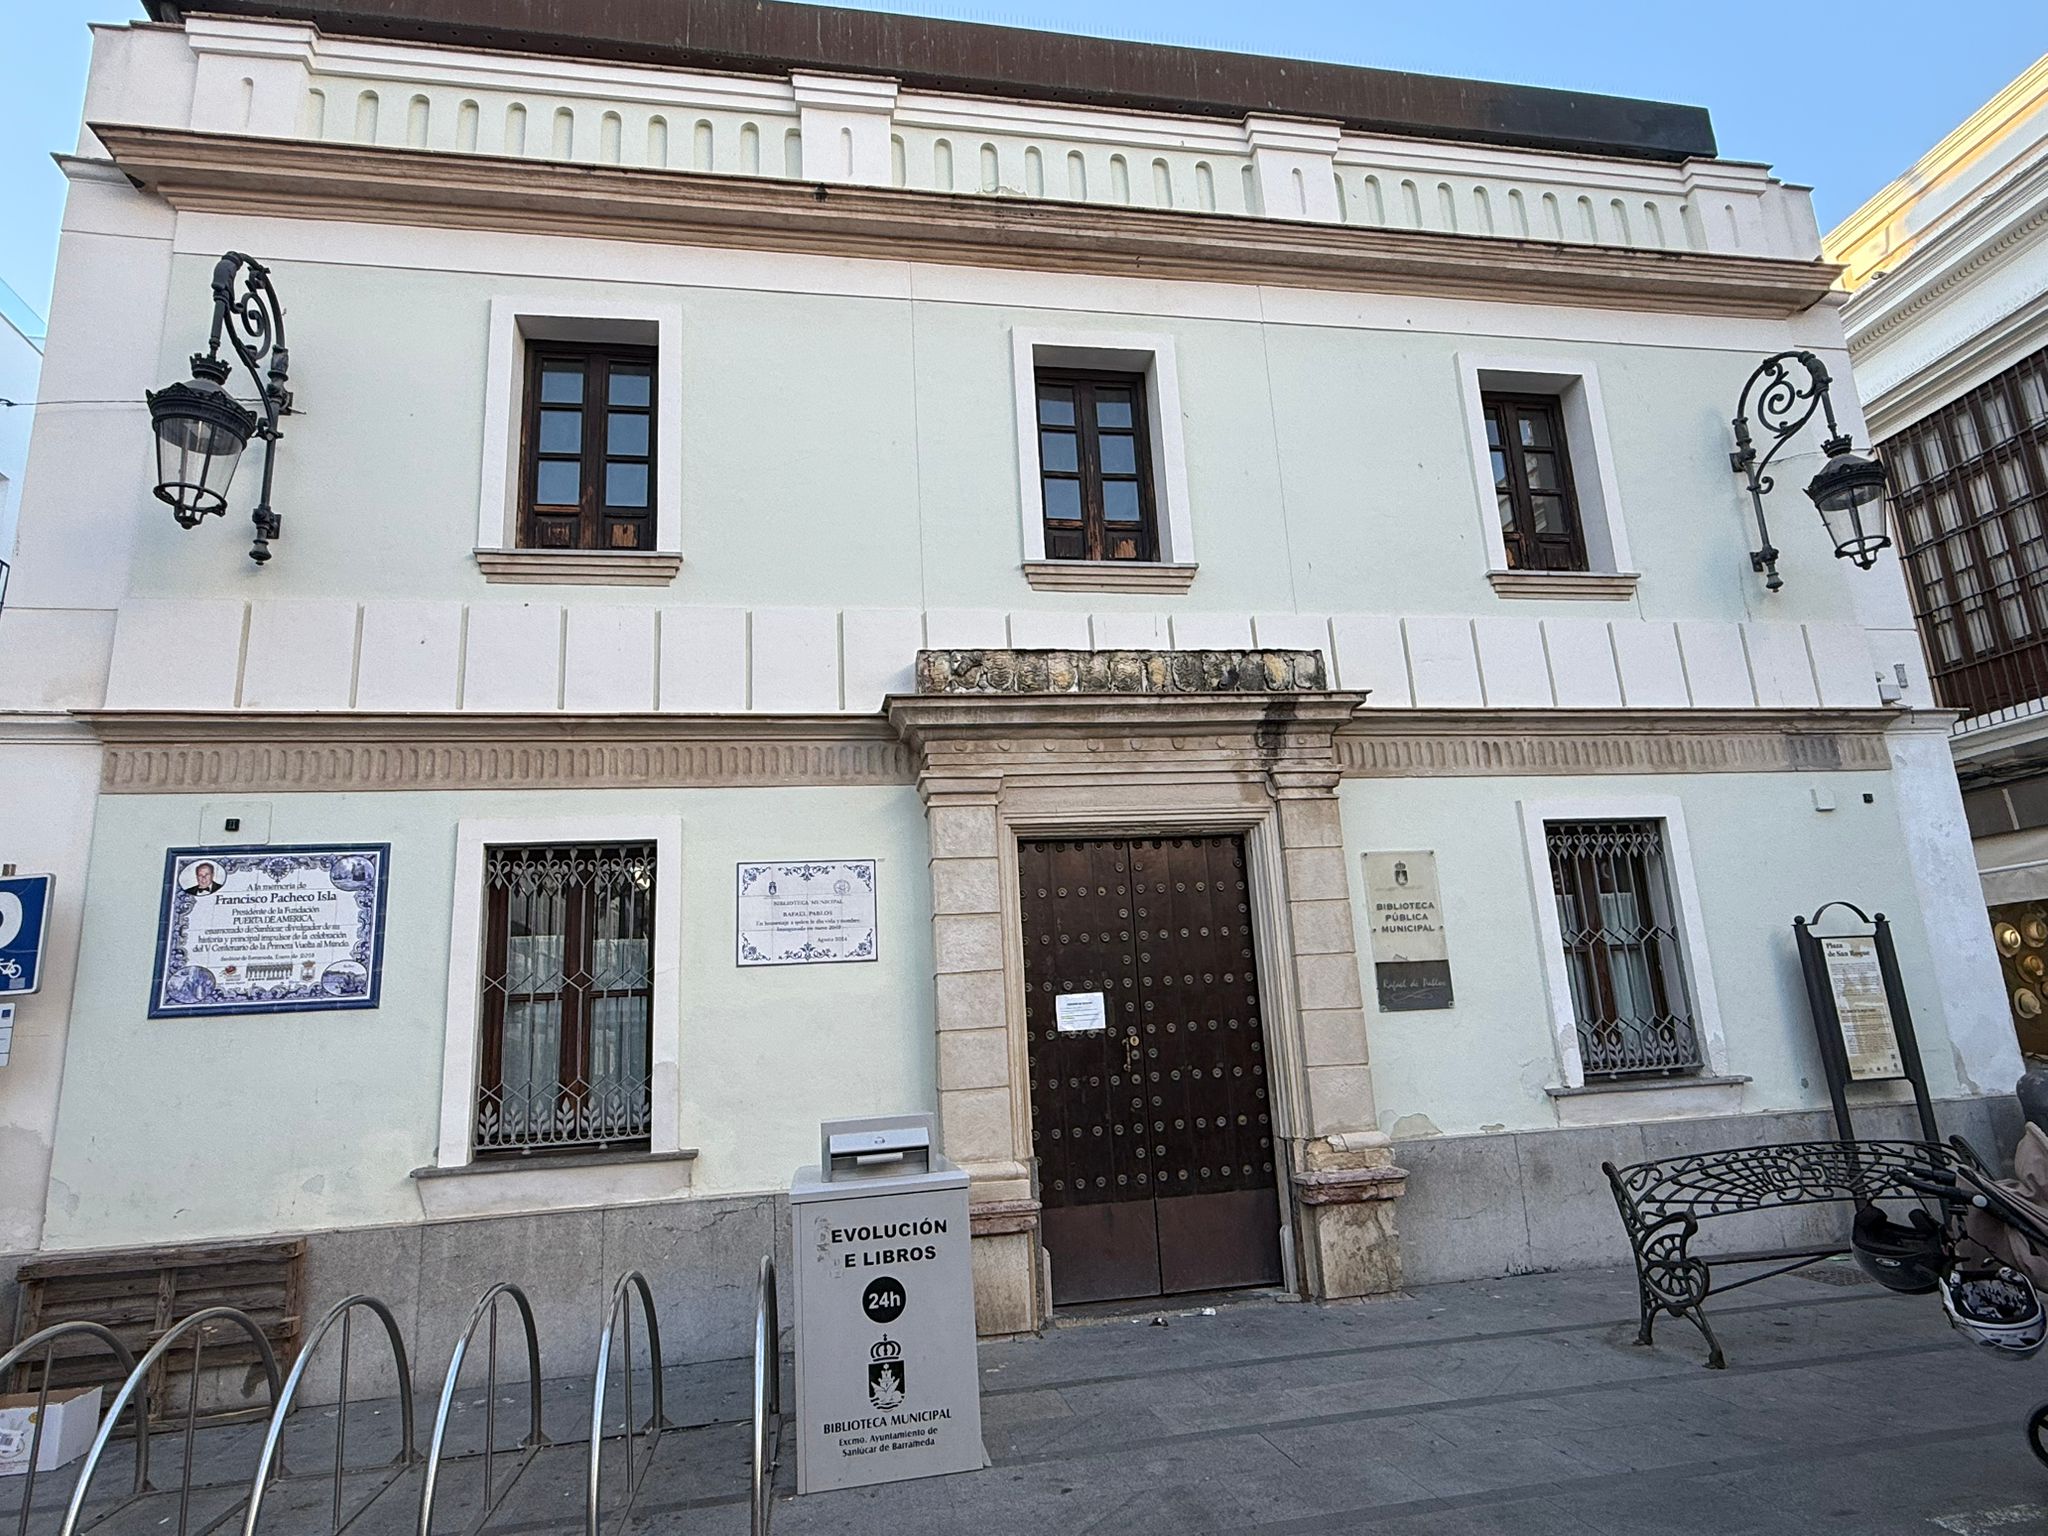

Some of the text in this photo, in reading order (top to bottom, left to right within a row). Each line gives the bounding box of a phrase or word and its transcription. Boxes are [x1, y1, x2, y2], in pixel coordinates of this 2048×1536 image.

[247, 883, 254, 891] A
[215, 890, 337, 905] Francisco Pacheco Isla
[232, 908, 267, 916] Presidente
[267, 907, 277, 915] de
[284, 905, 320, 914] Fundación
[1376, 902, 1435, 911] BIBLIOTECA
[233, 916, 263, 925] PUERTA
[263, 915, 274, 924] DE
[1385, 912, 1428, 922] PÚBLICA
[205, 927, 243, 935] enamorado
[245, 926, 254, 934] de
[285, 924, 321, 934] divulgador
[323, 923, 332, 931] de
[1381, 924, 1435, 933] MUNICIPAL
[198, 935, 223, 944] historia
[230, 935, 260, 945] principal
[261, 934, 291, 944] impulsor
[292, 933, 301, 941] de
[192, 944, 204, 952] del
[204, 944, 211, 952] V
[211, 943, 248, 952] Centenario
[249, 942, 259, 951] de
[259, 942, 265, 950] la
[267, 941, 293, 950] Primera
[294, 941, 315, 949] Vuelta
[1383, 978, 1407, 992] Rafael
[863, 1245, 937, 1267] LIBROS
[868, 1290, 901, 1310] 24h
[823, 1408, 952, 1434] BIBLIOTECA MUNICIPAL
[838, 1426, 938, 1448] Excmo. Ayuntamiento de
[841, 1437, 936, 1458] Sanlúcar de Barrameda
